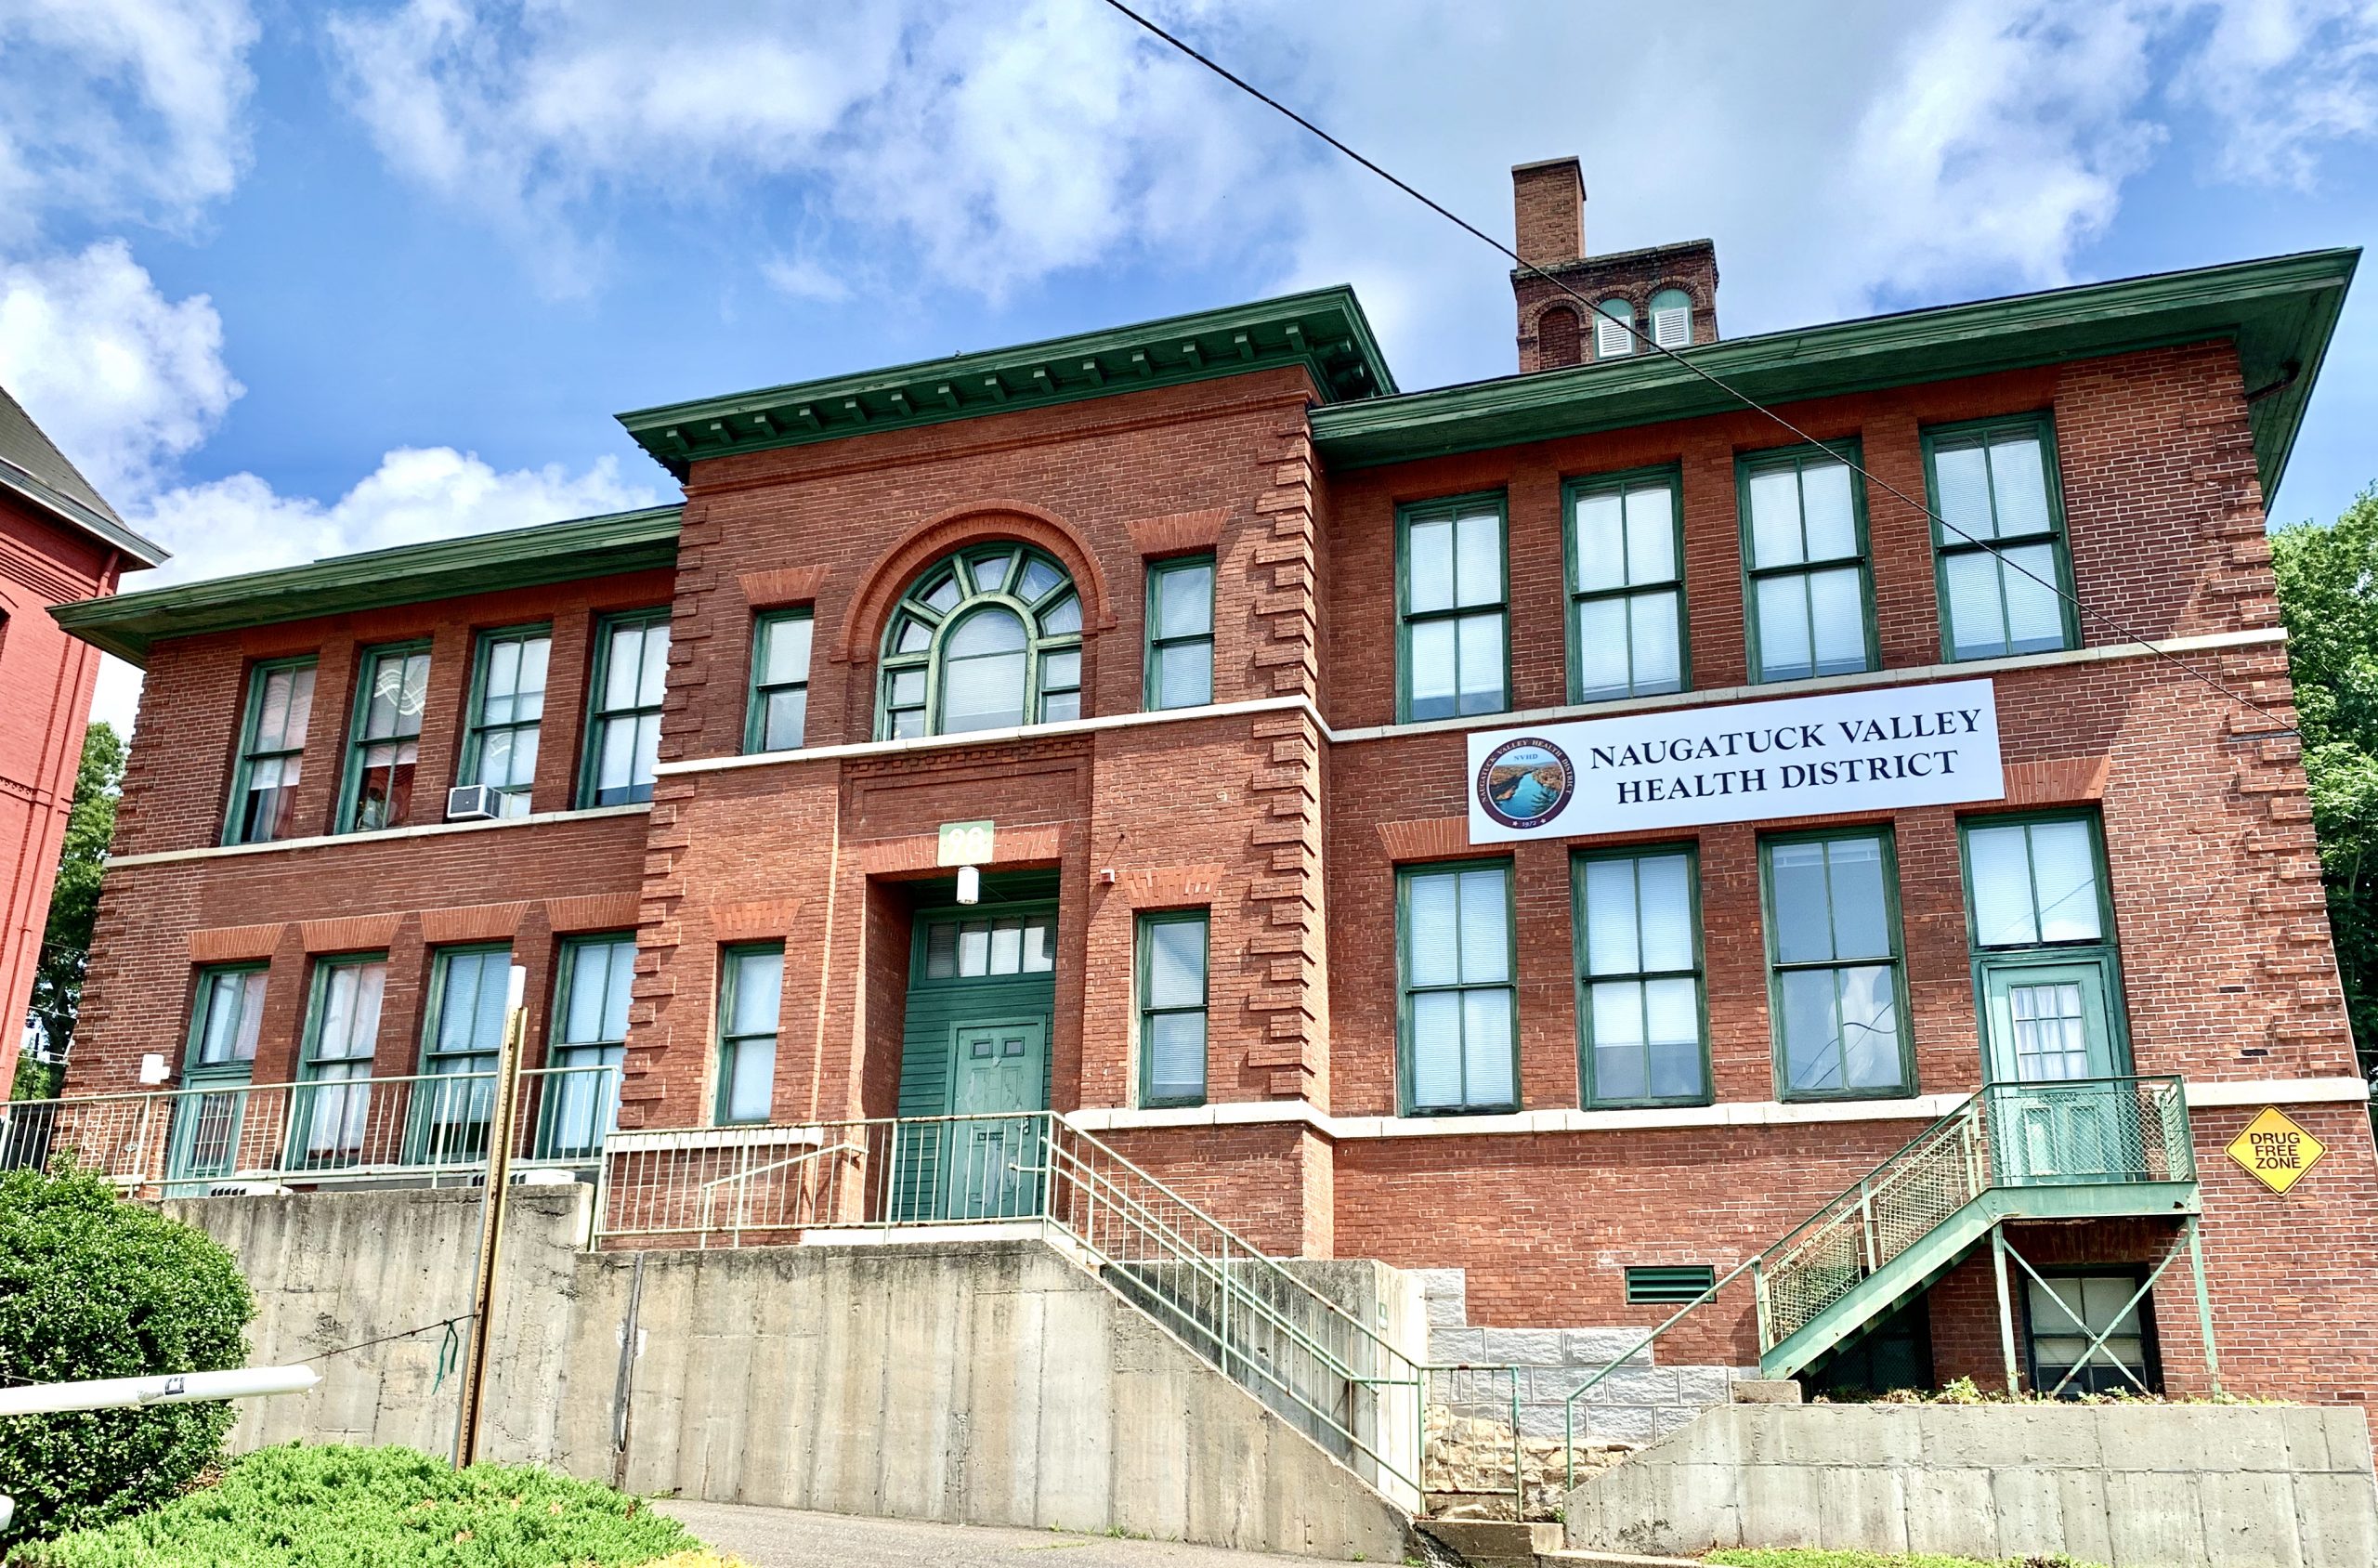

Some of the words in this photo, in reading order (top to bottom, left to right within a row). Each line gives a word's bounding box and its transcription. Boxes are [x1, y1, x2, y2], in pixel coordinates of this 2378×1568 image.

[1590, 724, 1826, 769] NAUGATUCK
[1837, 709, 1981, 743] VALLEY
[1497, 740, 1528, 754] VALLEY
[1532, 739, 1562, 757] HEALTH
[1561, 758, 1574, 794] DISTRICT
[1617, 768, 1768, 804] HEALTH
[1780, 750, 1958, 789] DISTRICT
[948, 827, 985, 861] 98
[2250, 1132, 2300, 1144] DRUG
[2254, 1144, 2298, 1156] FREE
[2255, 1156, 2302, 1169] ZONE
